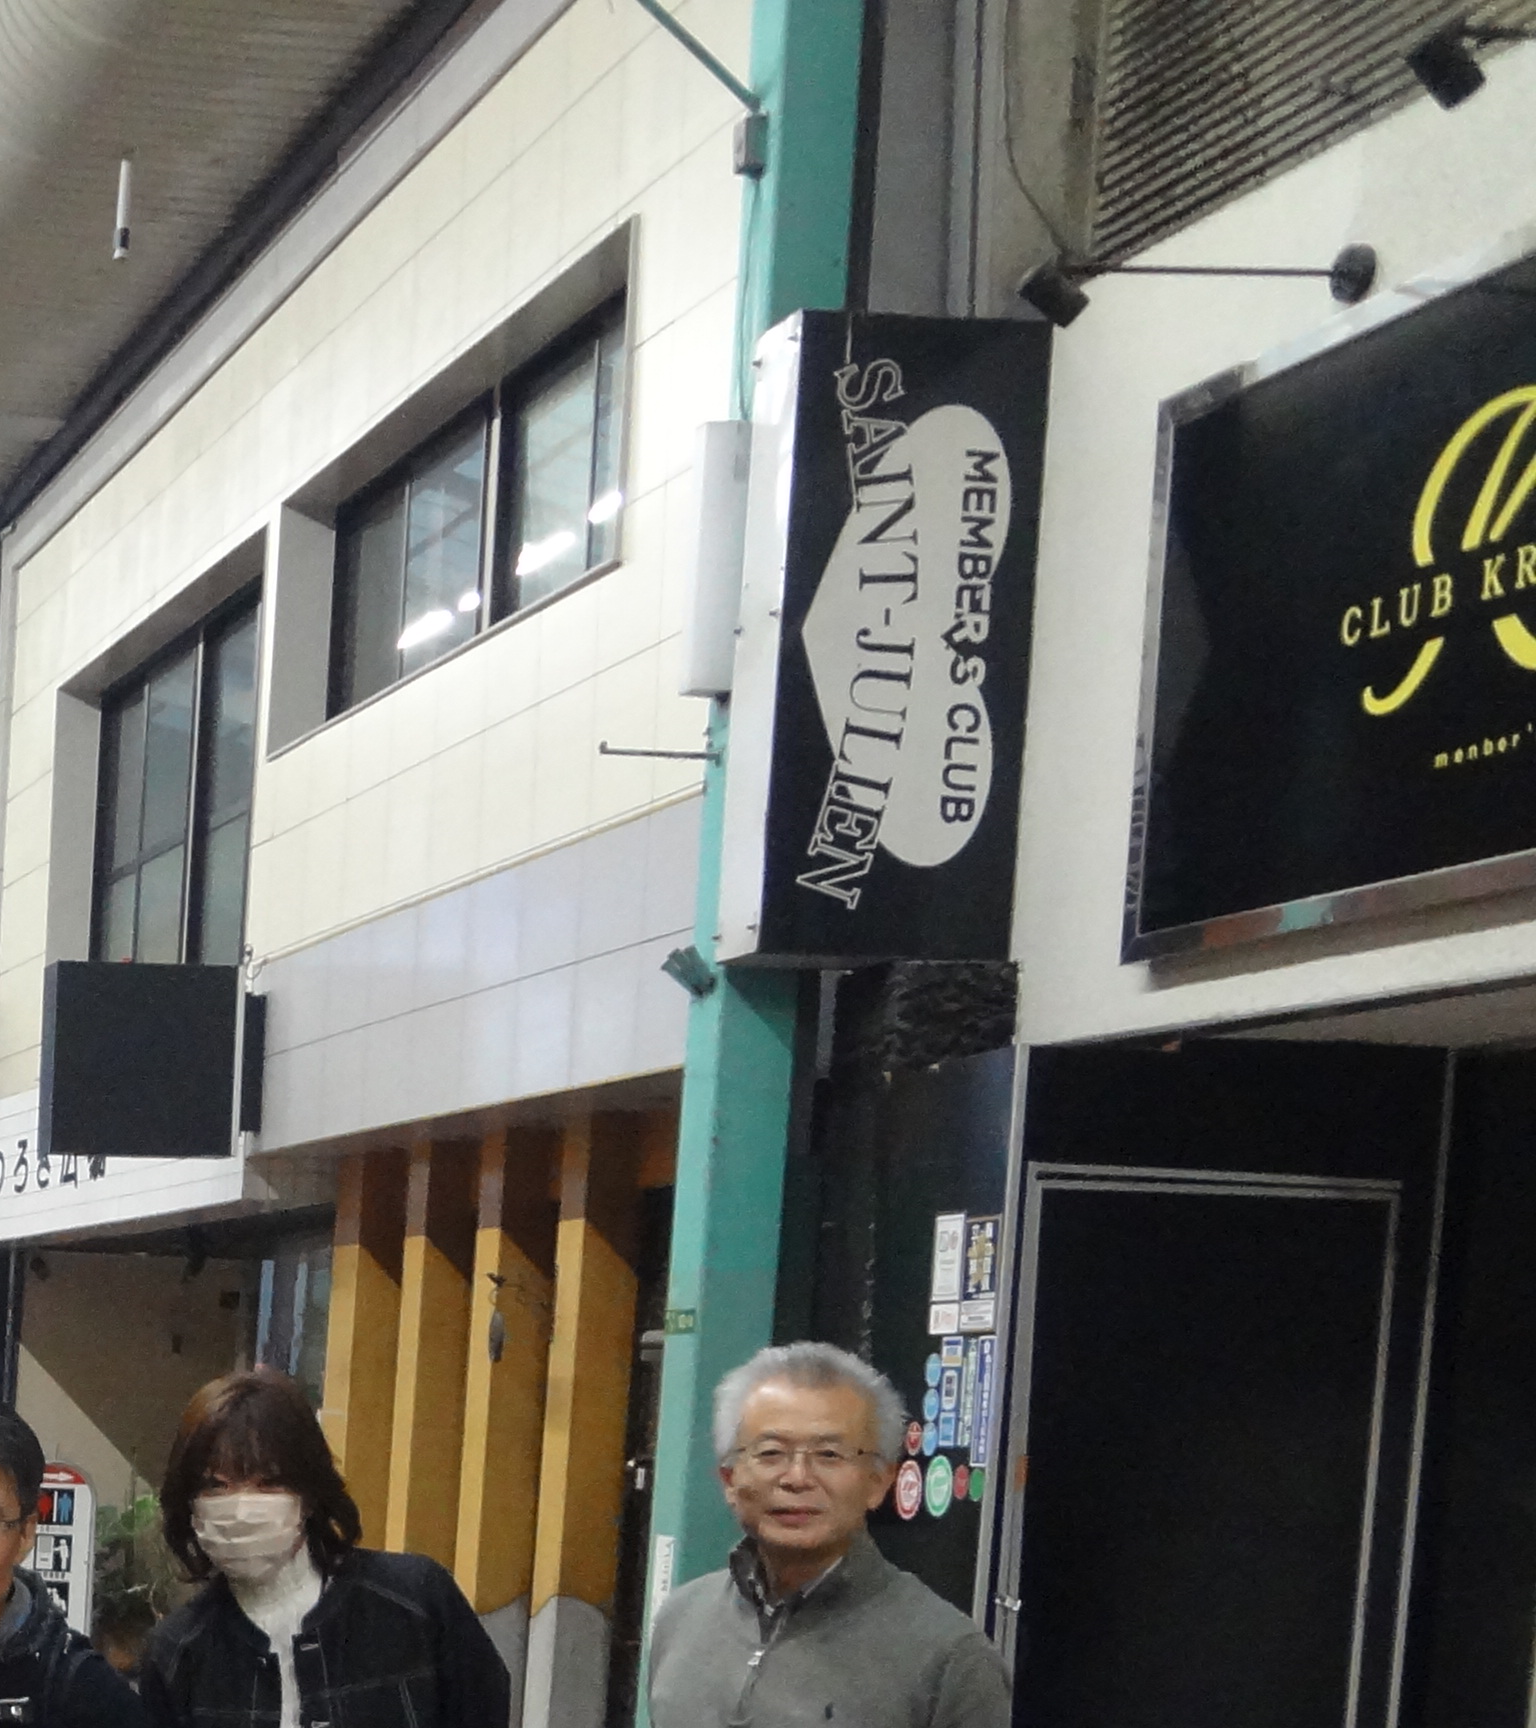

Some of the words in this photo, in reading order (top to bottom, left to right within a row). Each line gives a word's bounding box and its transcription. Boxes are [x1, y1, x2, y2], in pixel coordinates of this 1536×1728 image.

[796, 357, 919, 911] SAINT-JULIEN
[1340, 572, 1455, 649] CLUB
[939, 704, 981, 826] CLUB
